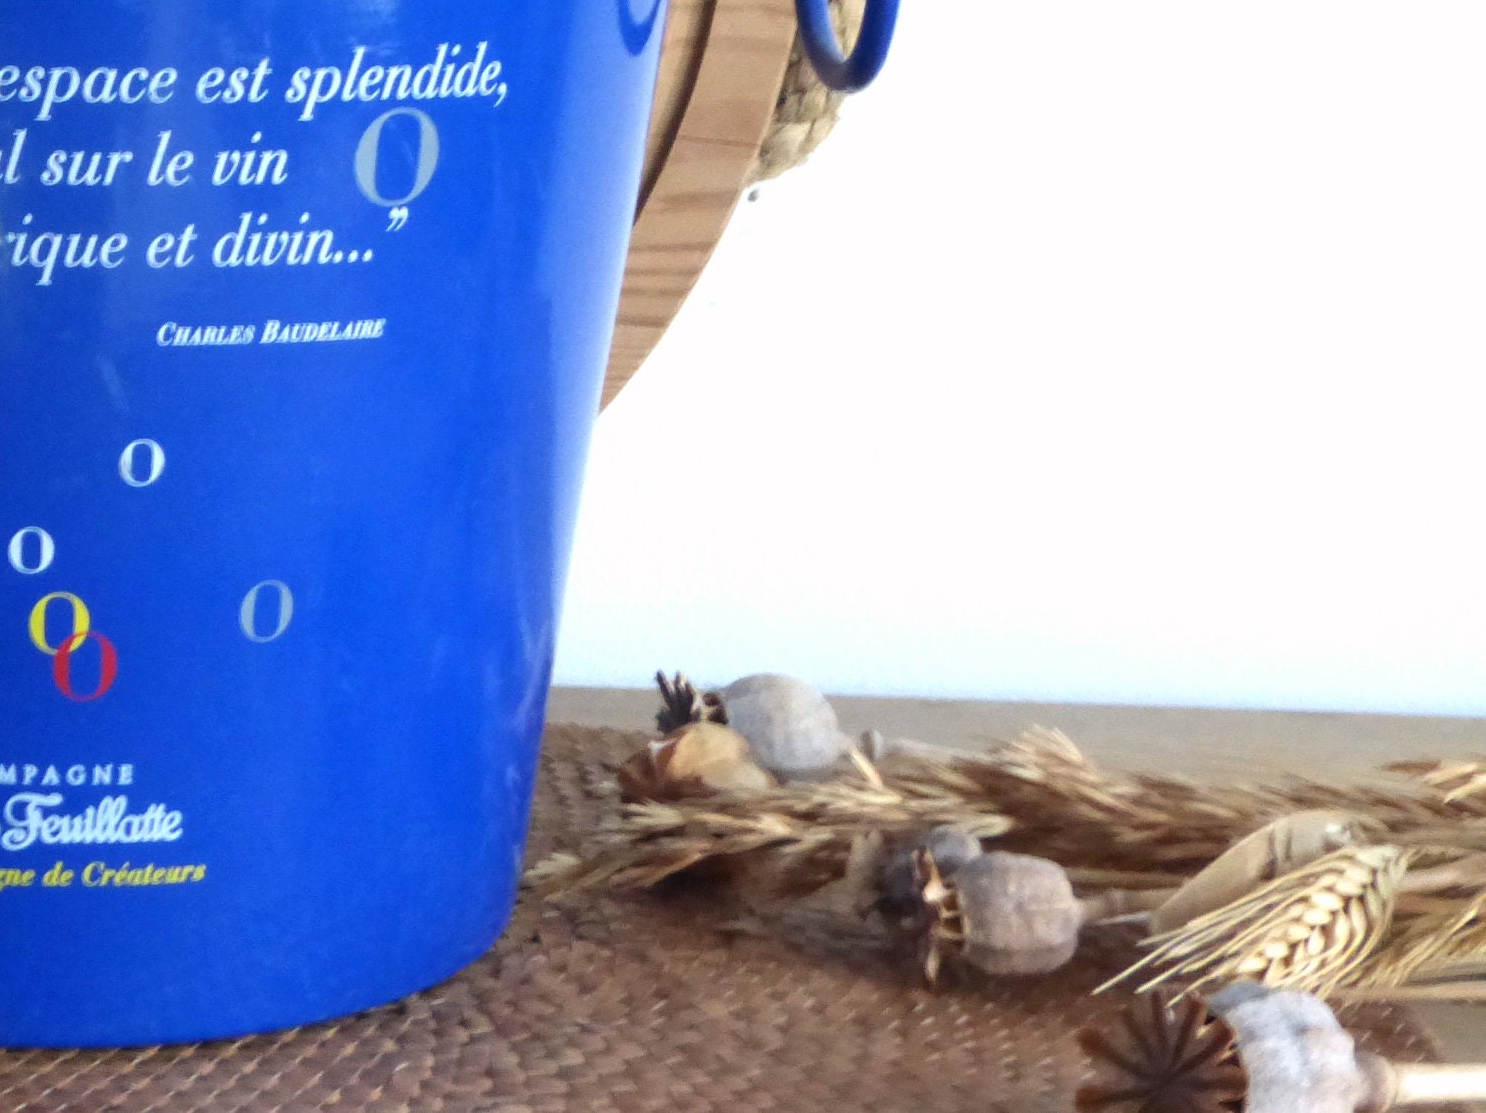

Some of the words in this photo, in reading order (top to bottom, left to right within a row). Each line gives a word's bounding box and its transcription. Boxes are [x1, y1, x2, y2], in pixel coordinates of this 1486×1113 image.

[195, 57, 273, 104] est
[284, 40, 508, 122] splendide,
[40, 149, 134, 186] sur
[146, 129, 195, 187] le
[211, 131, 289, 186] vin
[145, 223, 198, 269] et
[0, 791, 185, 851] Feuillatte
[42, 861, 75, 887] de
[81, 860, 207, 887] Créateurs
